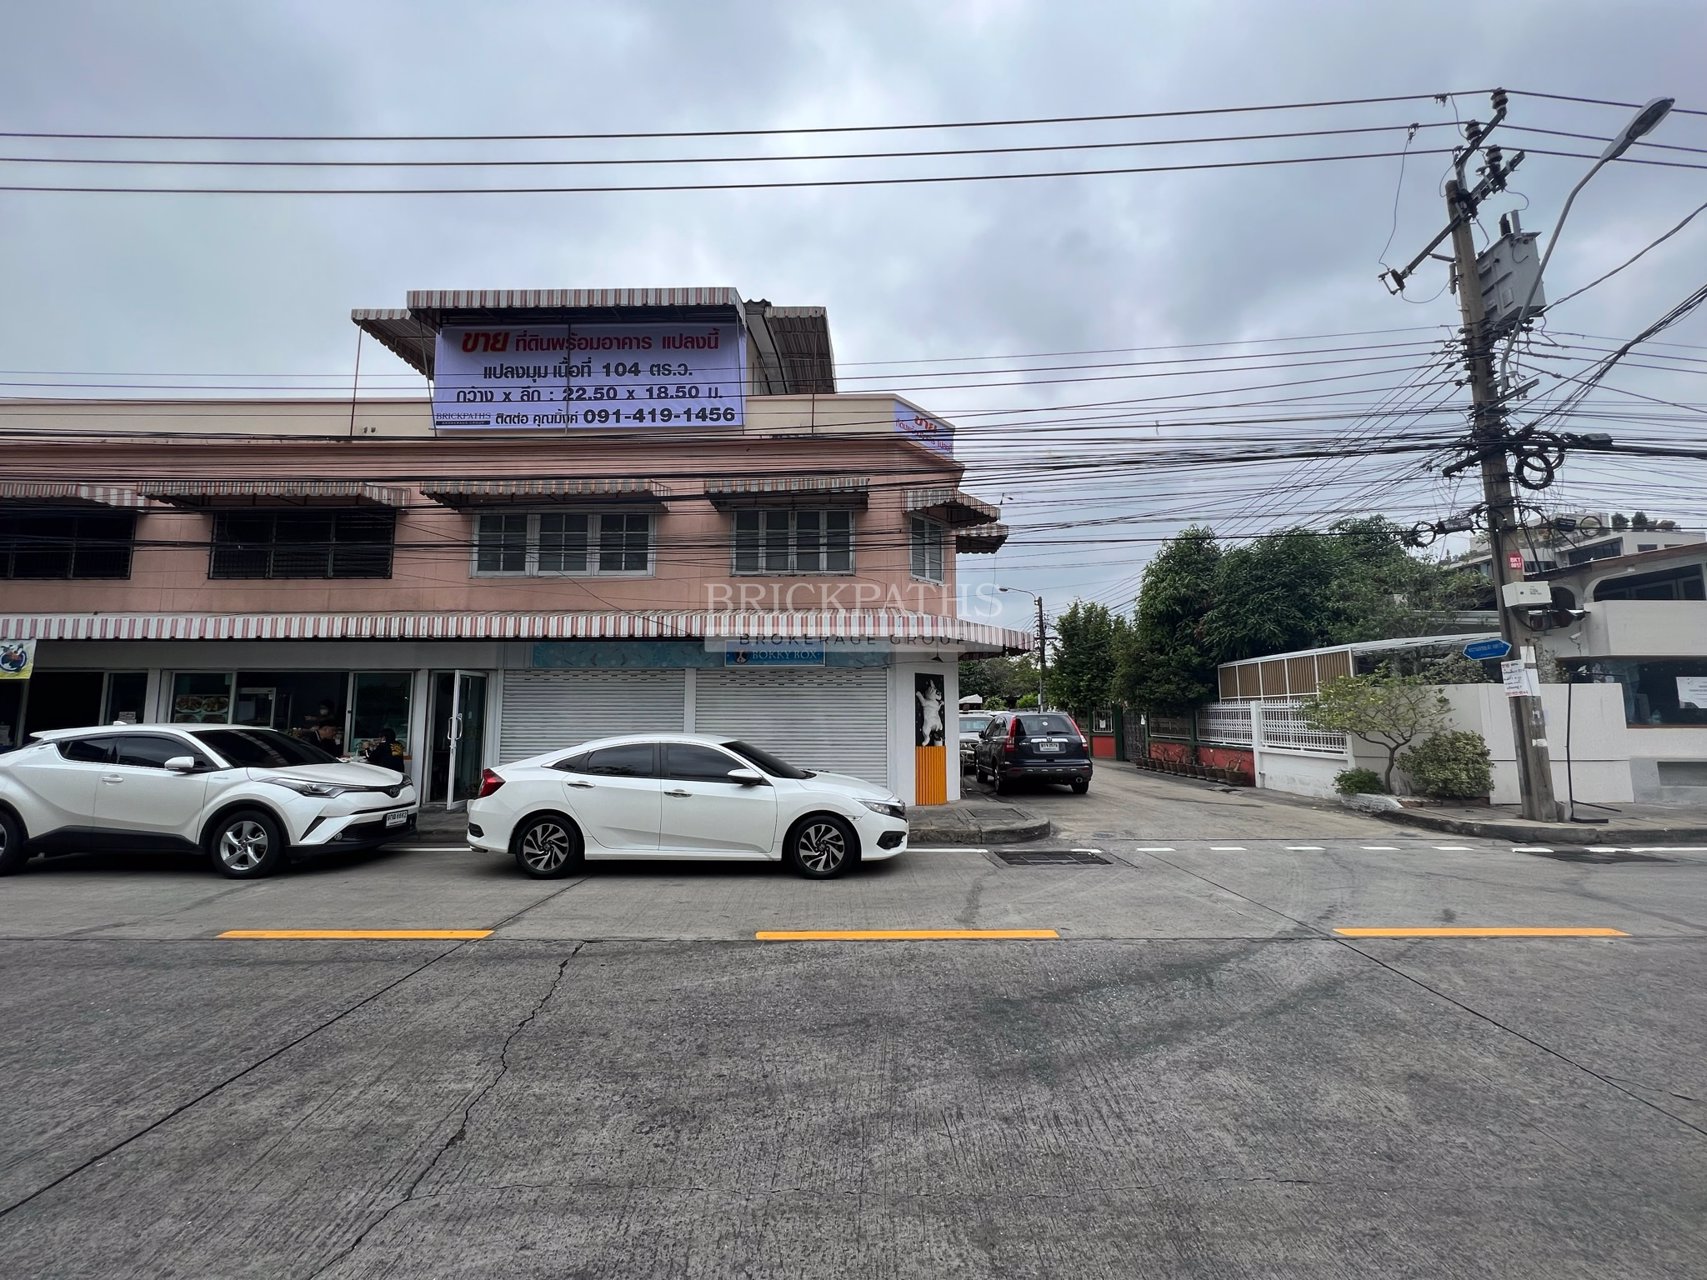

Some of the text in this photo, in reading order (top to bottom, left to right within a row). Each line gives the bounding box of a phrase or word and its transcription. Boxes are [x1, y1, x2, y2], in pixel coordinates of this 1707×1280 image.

[462, 328, 720, 353] ขาย ที่ดินพร้อมอาคาร แปลงนี้
[483, 357, 693, 383] แปลงมุม เนื้อที่ 104 ตร.ว.
[502, 391, 512, 402] x
[562, 386, 618, 401] 22.50
[626, 389, 636, 400] x
[645, 385, 700, 399] 18.50
[708, 387, 723, 399] ม.
[436, 412, 491, 420] BRICKPATHS
[495, 412, 529, 425] ติดต่อ
[583, 407, 735, 424] 091-419-1456
